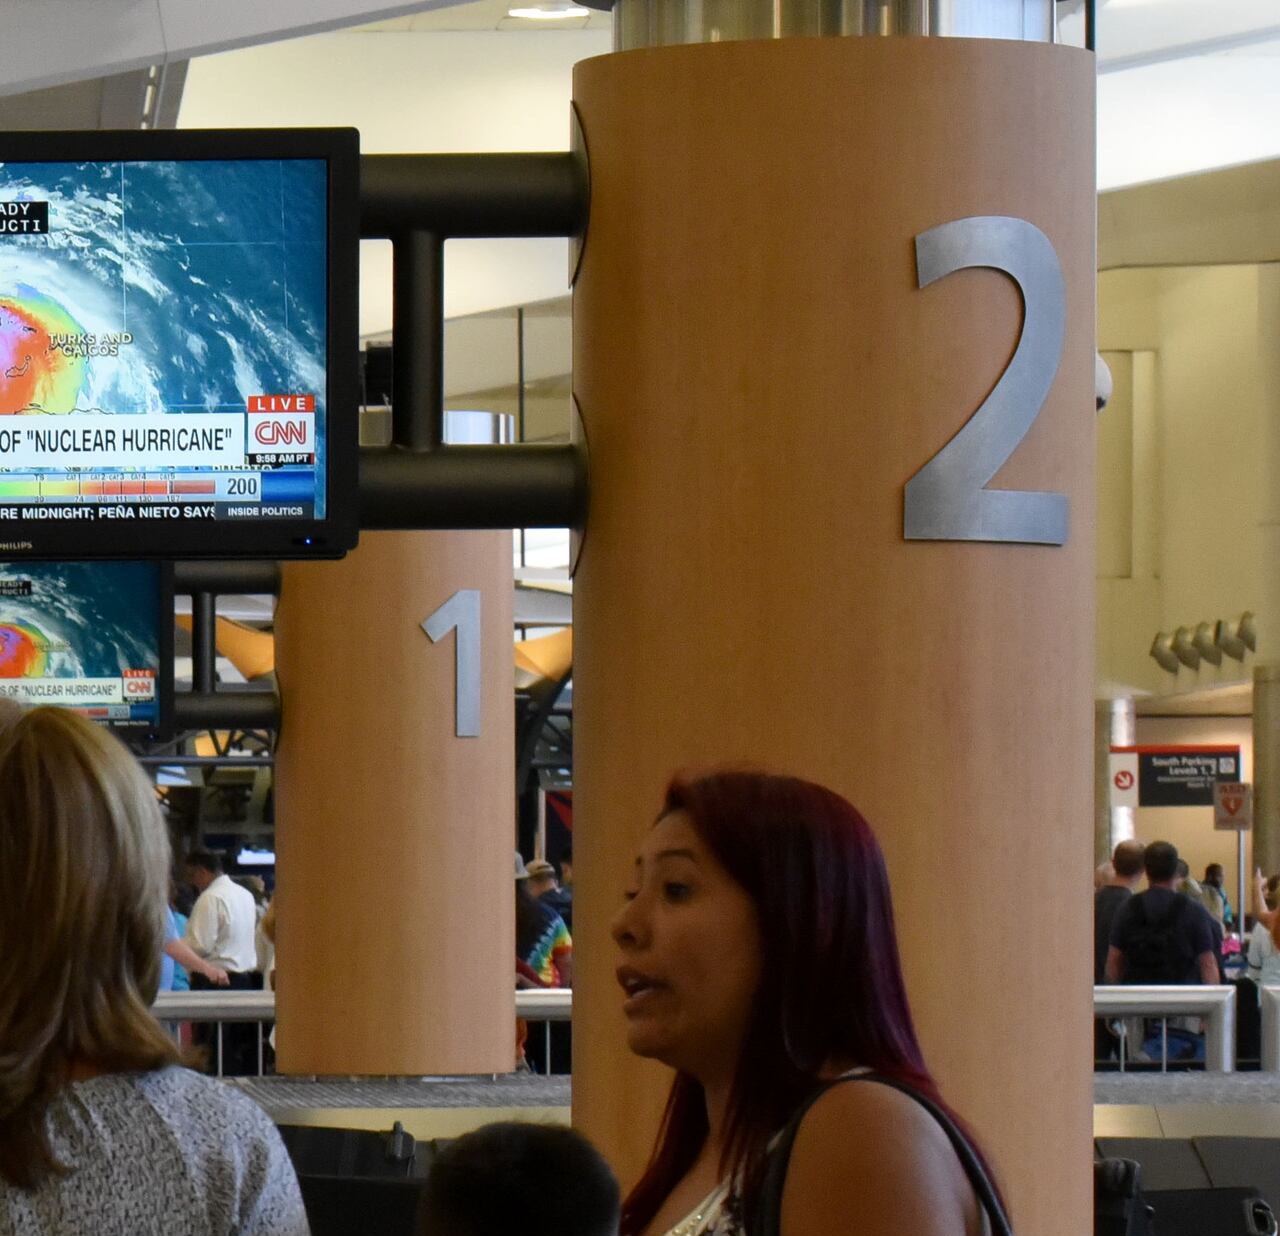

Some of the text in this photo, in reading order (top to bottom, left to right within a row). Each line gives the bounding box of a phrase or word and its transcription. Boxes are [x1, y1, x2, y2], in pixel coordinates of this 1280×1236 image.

[48, 332, 133, 344] TURKS AND
[62, 345, 118, 356] CAICOS
[904, 215, 1070, 546] 2
[257, 398, 306, 410] LIVE
[254, 420, 306, 445] CNN
[27, 428, 116, 452] "NUCLEAR
[122, 428, 232, 451] HURRICANE"
[256, 454, 308, 463] 9:58 AM PT
[227, 478, 257, 495] 200
[22, 508, 94, 520] MIDNIGHT;
[98, 506, 134, 519] PEÑA
[139, 507, 180, 518] NIETO
[228, 506, 304, 516] INSIDE POLITICS
[420, 589, 481, 738] 1
